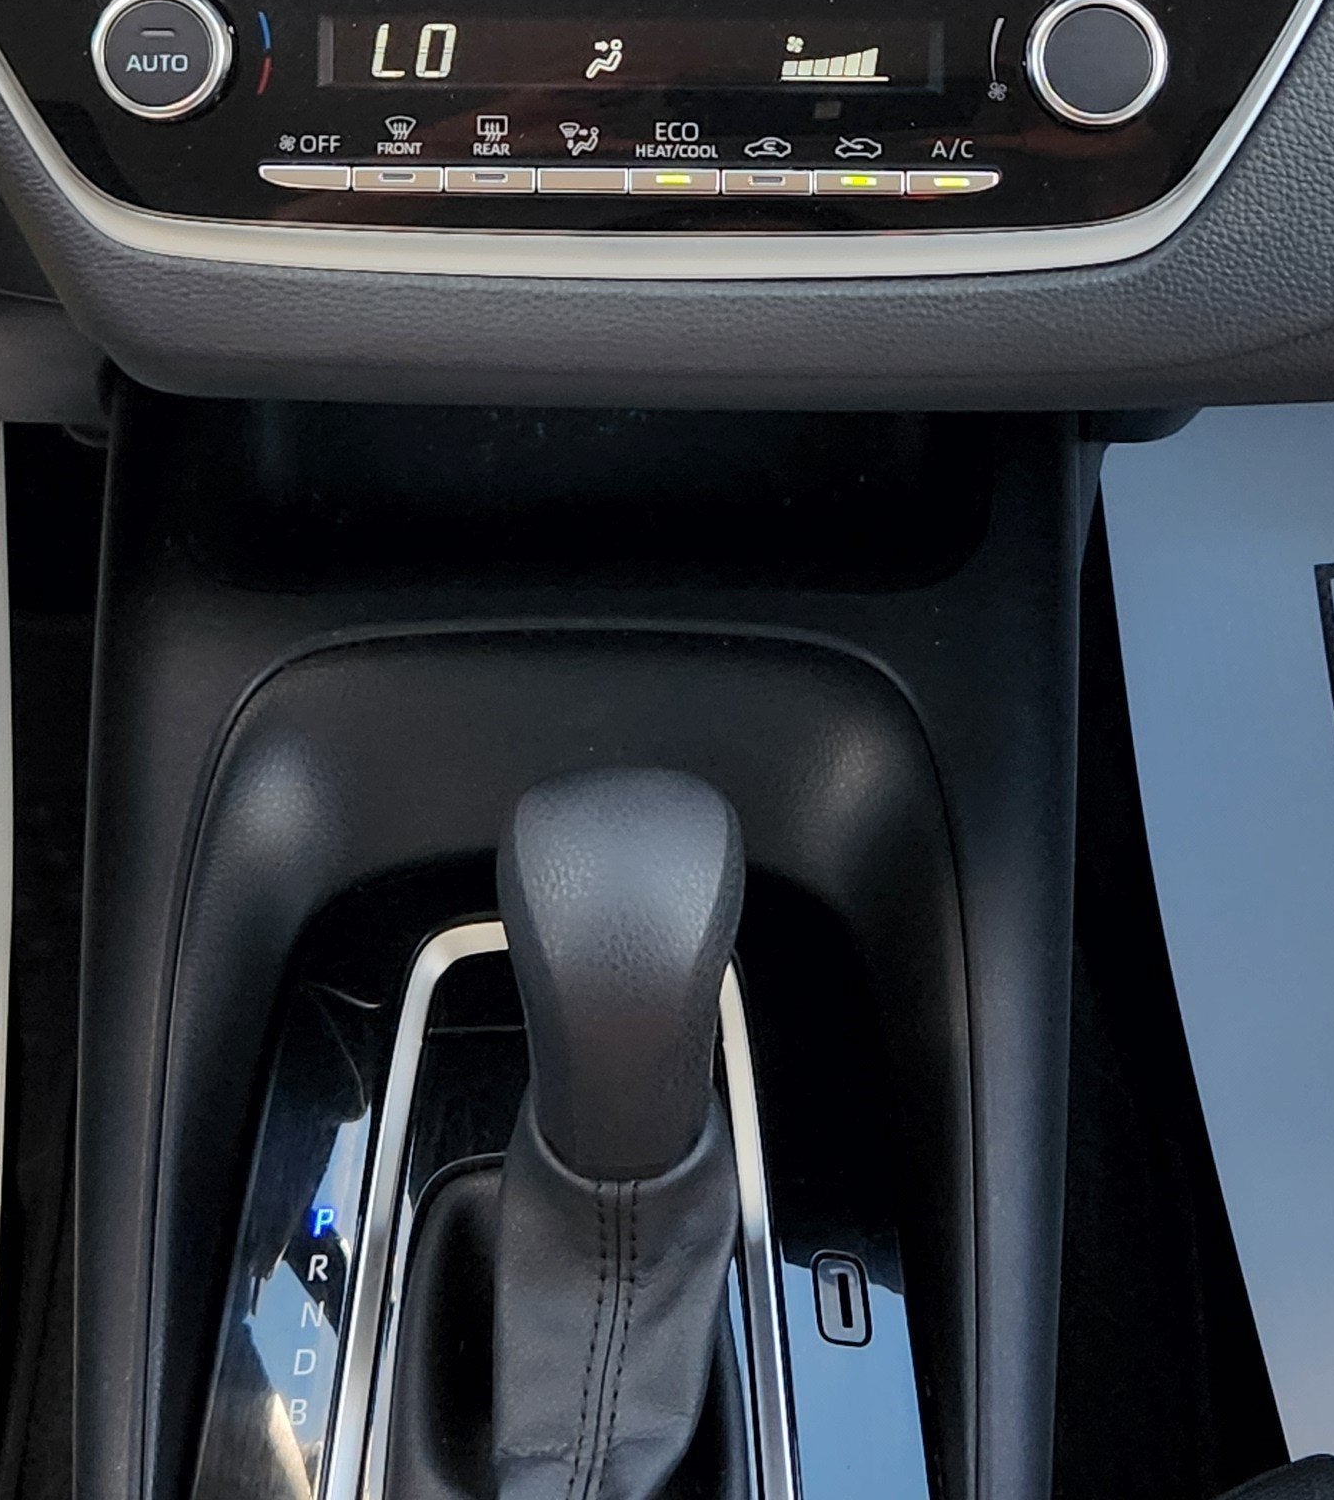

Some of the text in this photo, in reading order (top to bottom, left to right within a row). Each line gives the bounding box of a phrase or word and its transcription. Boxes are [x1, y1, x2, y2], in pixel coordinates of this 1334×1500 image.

[371, 23, 458, 80] LO
[126, 53, 188, 73] AUTO
[655, 122, 699, 142] ECO
[300, 134, 341, 154] OFF
[377, 141, 423, 156] FRONT
[472, 141, 511, 156] REAR
[635, 143, 718, 159] HEAT/COOL
[931, 139, 974, 159] A/C
[313, 1207, 334, 1236] P
[307, 1254, 328, 1282] R
[300, 1301, 325, 1328] N
[293, 1349, 317, 1376] D
[289, 1399, 308, 1426] B
